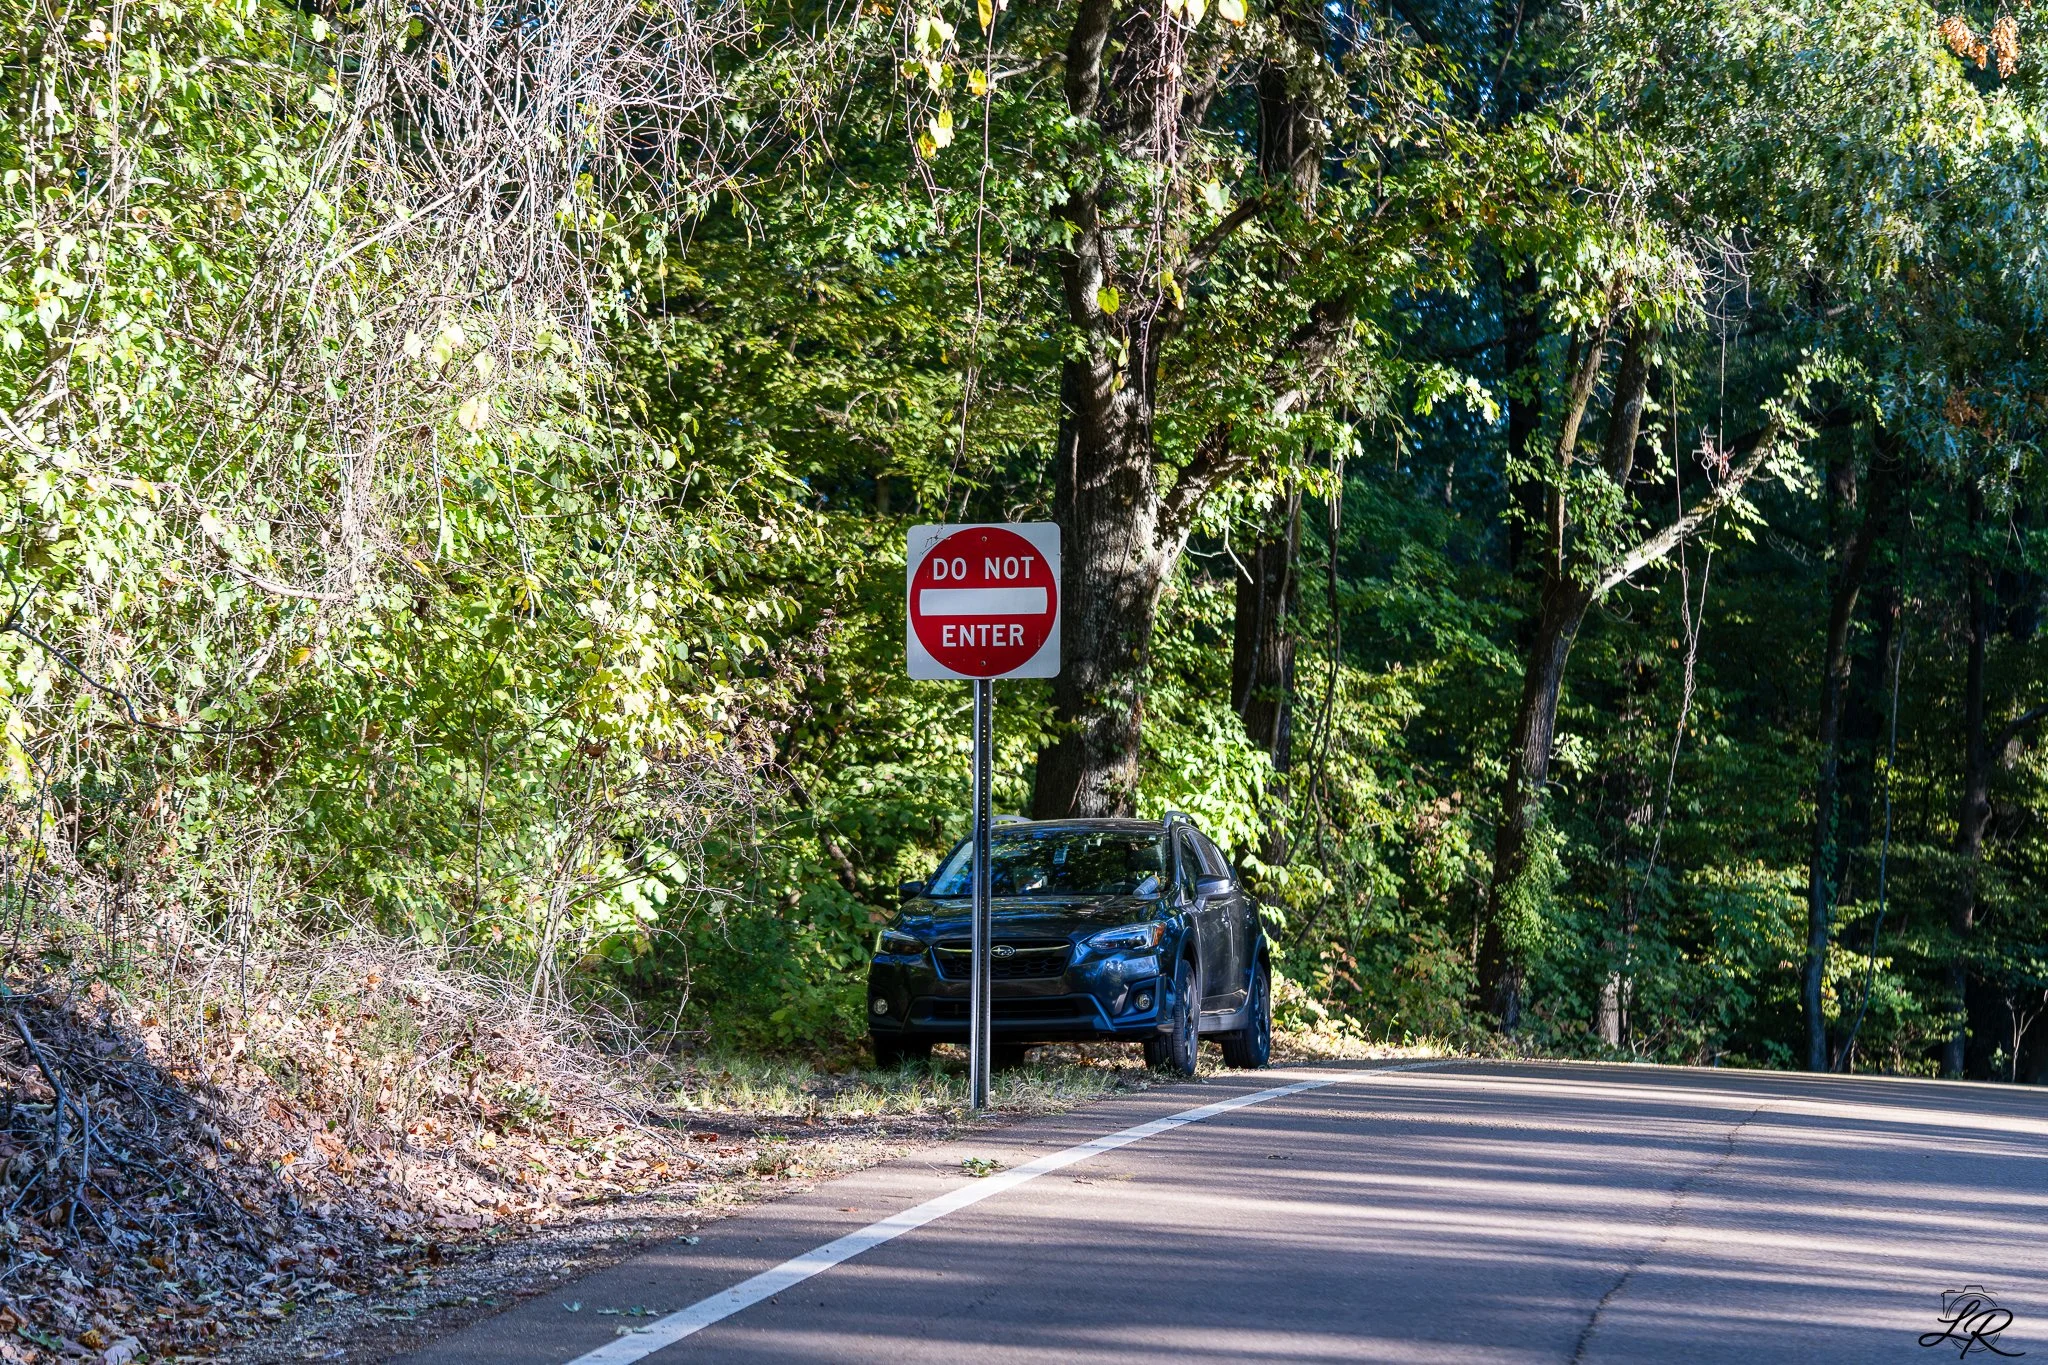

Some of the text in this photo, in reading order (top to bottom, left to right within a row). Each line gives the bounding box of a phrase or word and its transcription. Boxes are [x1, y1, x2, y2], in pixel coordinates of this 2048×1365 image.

[933, 556, 1034, 580] DO NOT
[942, 624, 1025, 647] ENTER
